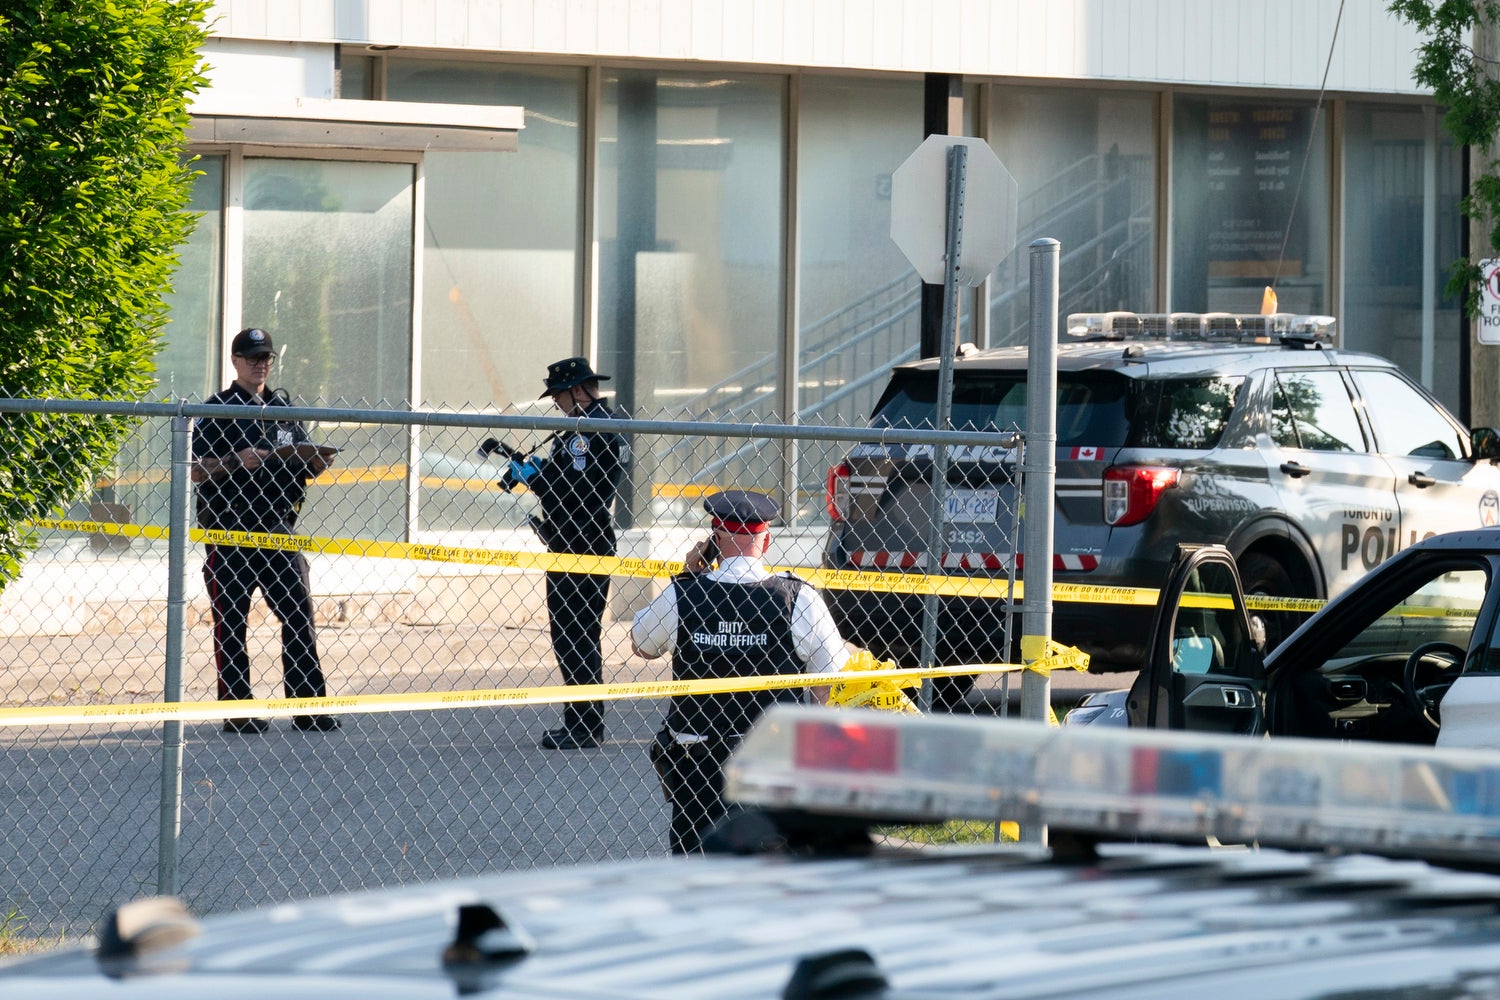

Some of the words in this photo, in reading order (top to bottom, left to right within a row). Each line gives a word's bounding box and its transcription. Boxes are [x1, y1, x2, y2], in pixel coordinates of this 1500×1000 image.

[1187, 498, 1257, 512] SUPERVISOR
[1342, 504, 1392, 522] TORONTO
[208, 532, 234, 542] POLICE
[948, 530, 984, 544] 33S2
[414, 546, 440, 556] POLICE
[444, 549, 460, 558] LINE
[476, 550, 491, 559] NOT
[826, 572, 852, 581] POLICE
[855, 574, 872, 582] LINE
[906, 577, 931, 585] CROSS
[718, 621, 744, 634] DUTY
[694, 632, 728, 647] SENIOR
[729, 633, 768, 647] OFFICER
